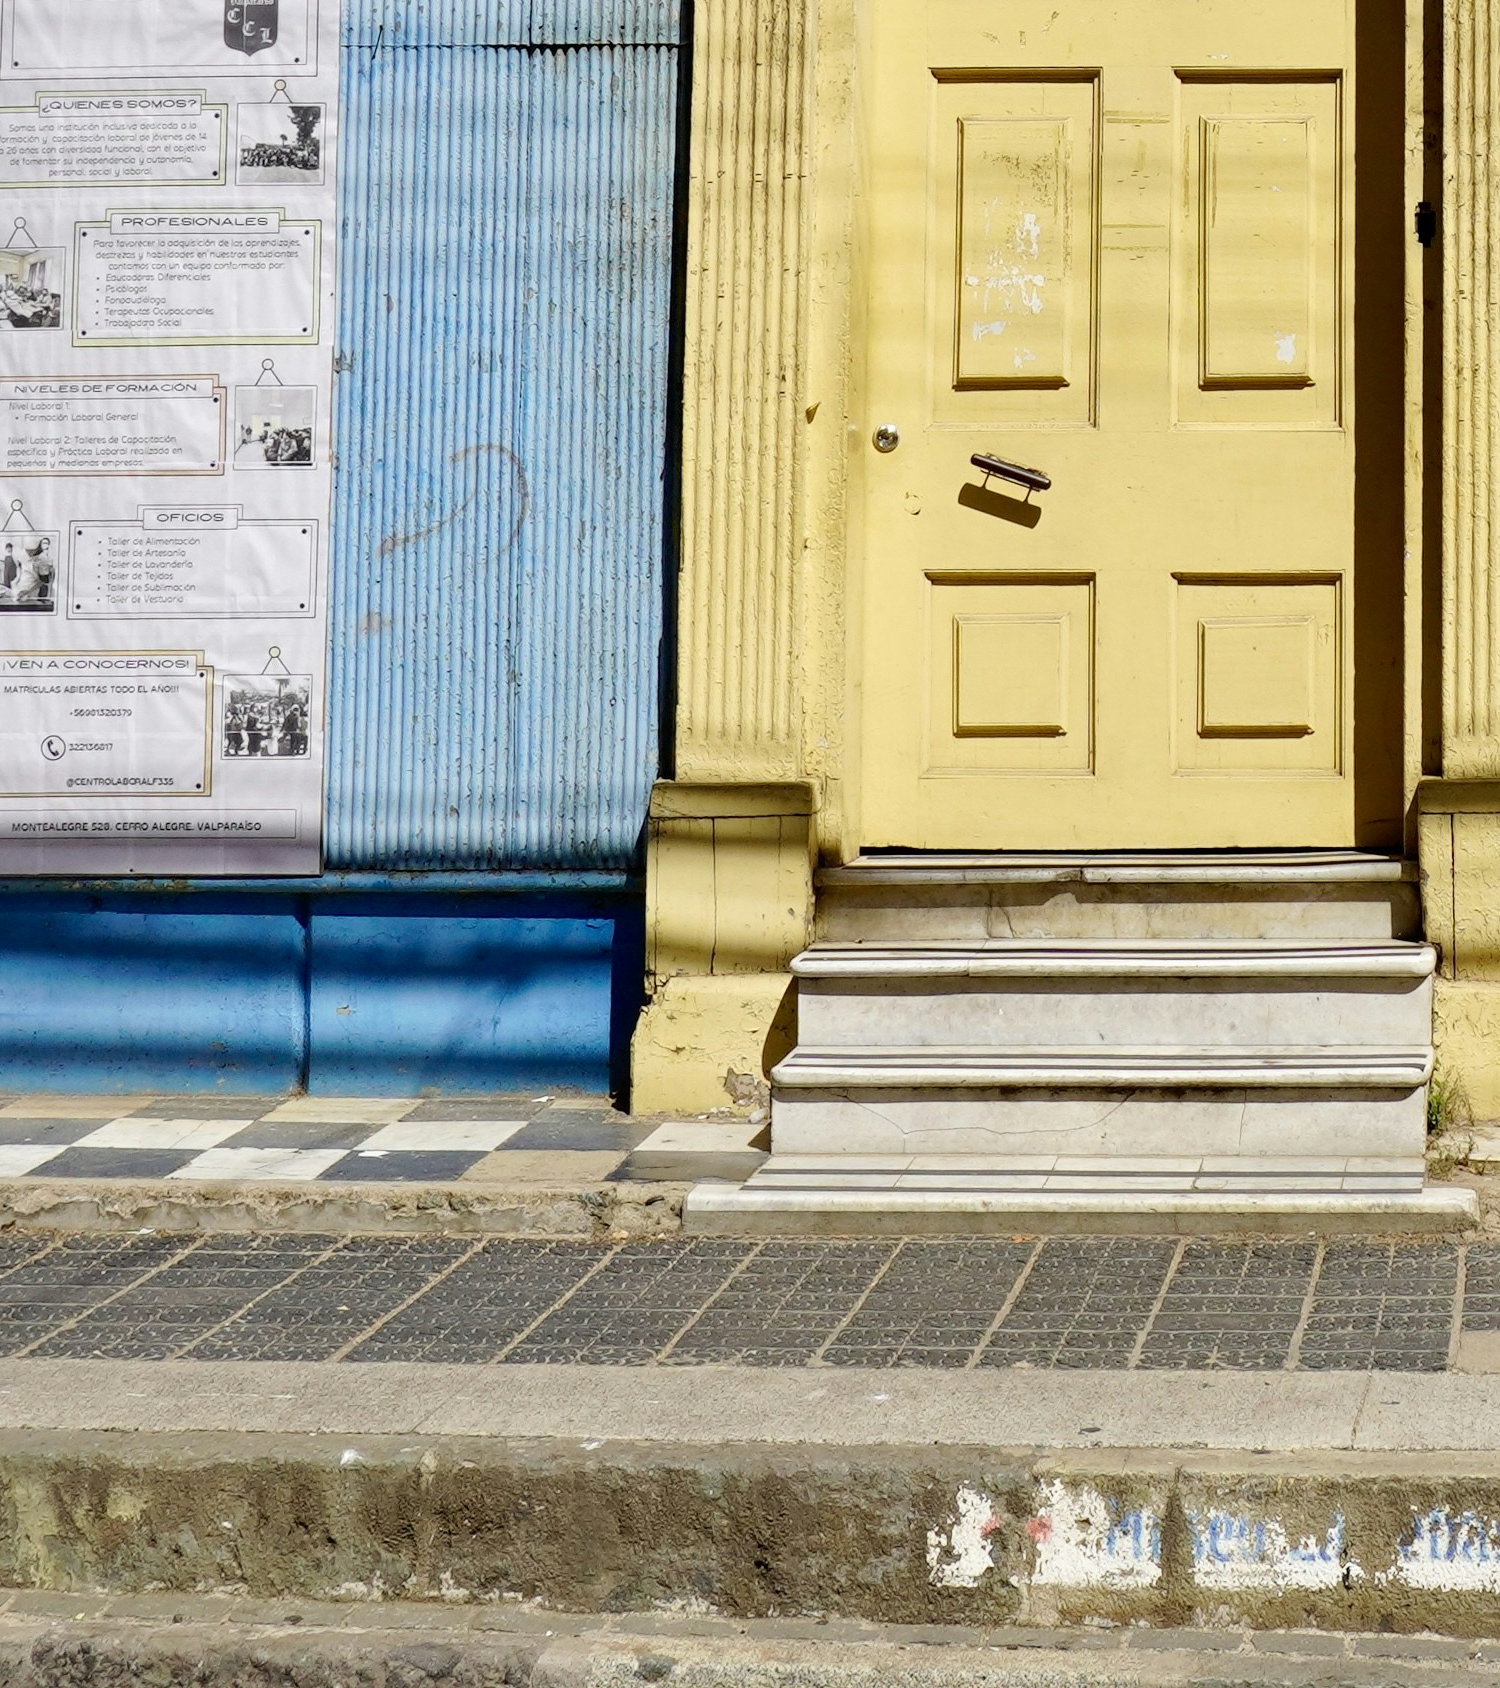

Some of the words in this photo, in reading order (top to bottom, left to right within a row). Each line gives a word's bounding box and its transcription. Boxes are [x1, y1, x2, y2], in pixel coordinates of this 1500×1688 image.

[42, 101, 123, 113] ¿QUIENES
[126, 99, 197, 109] SOMOS?
[121, 217, 269, 227] PROFESIONALES
[14, 385, 80, 394] NIVELES
[81, 385, 102, 393] DE
[105, 382, 198, 393] FORMACIÓN
[156, 513, 225, 523] OFICIOS
[3, 661, 42, 670] ¡VEN
[47, 660, 59, 668] A
[63, 659, 190, 669] CONOCERNOS!
[63, 685, 108, 694] ABIERTAS
[110, 686, 135, 694] TODO
[11, 823, 88, 832] MONTEALEGRE
[115, 823, 149, 832] CERRO
[197, 819, 262, 831] VALPARAÍSO
